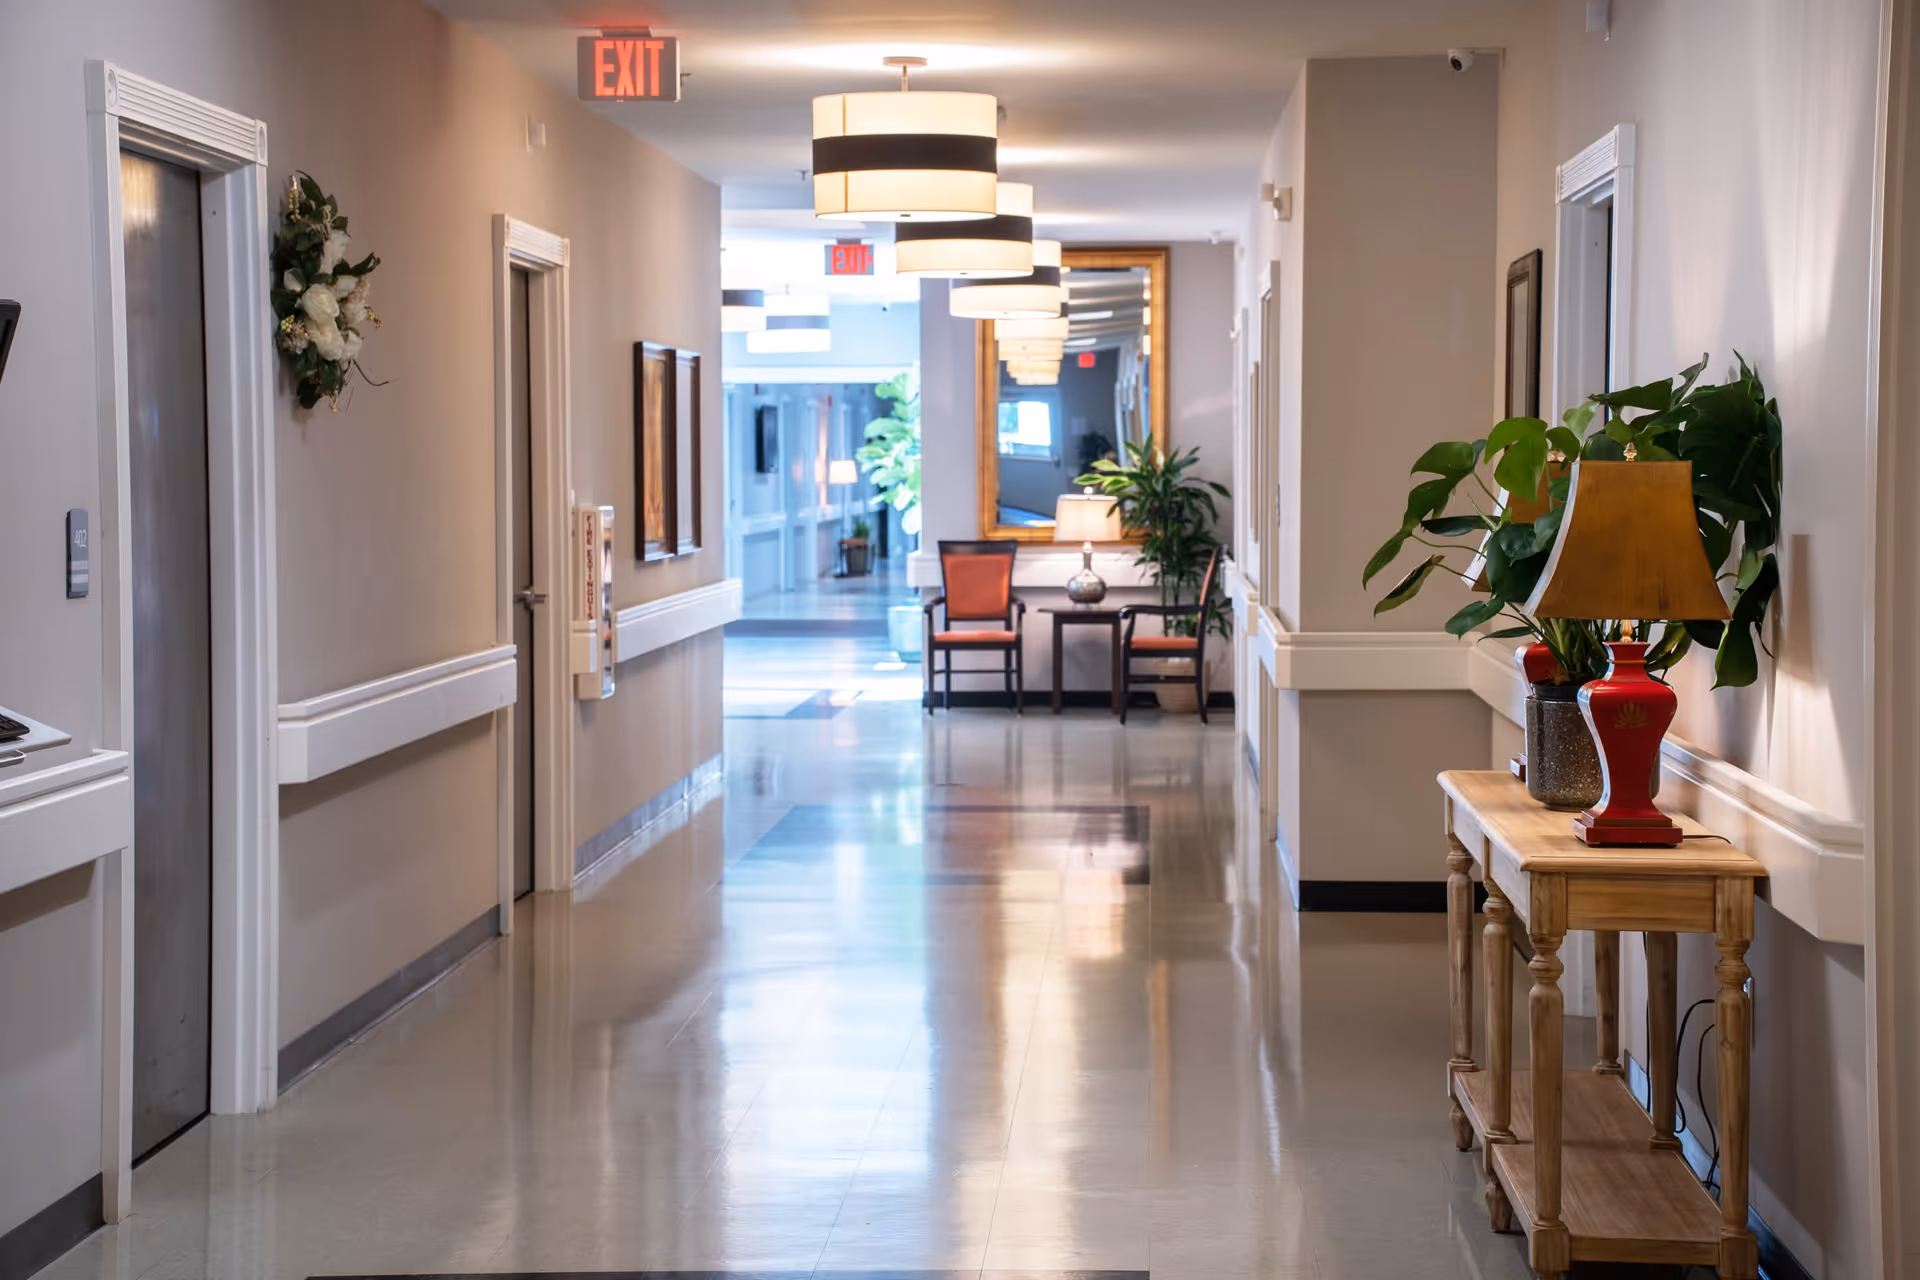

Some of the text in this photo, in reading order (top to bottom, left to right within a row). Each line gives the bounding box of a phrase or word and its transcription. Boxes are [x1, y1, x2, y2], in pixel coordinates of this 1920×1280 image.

[594, 40, 664, 97] EXIT
[832, 245, 869, 274] EXIT
[74, 529, 87, 548] 402
[586, 515, 594, 621] FIRE EXTINGUIS
